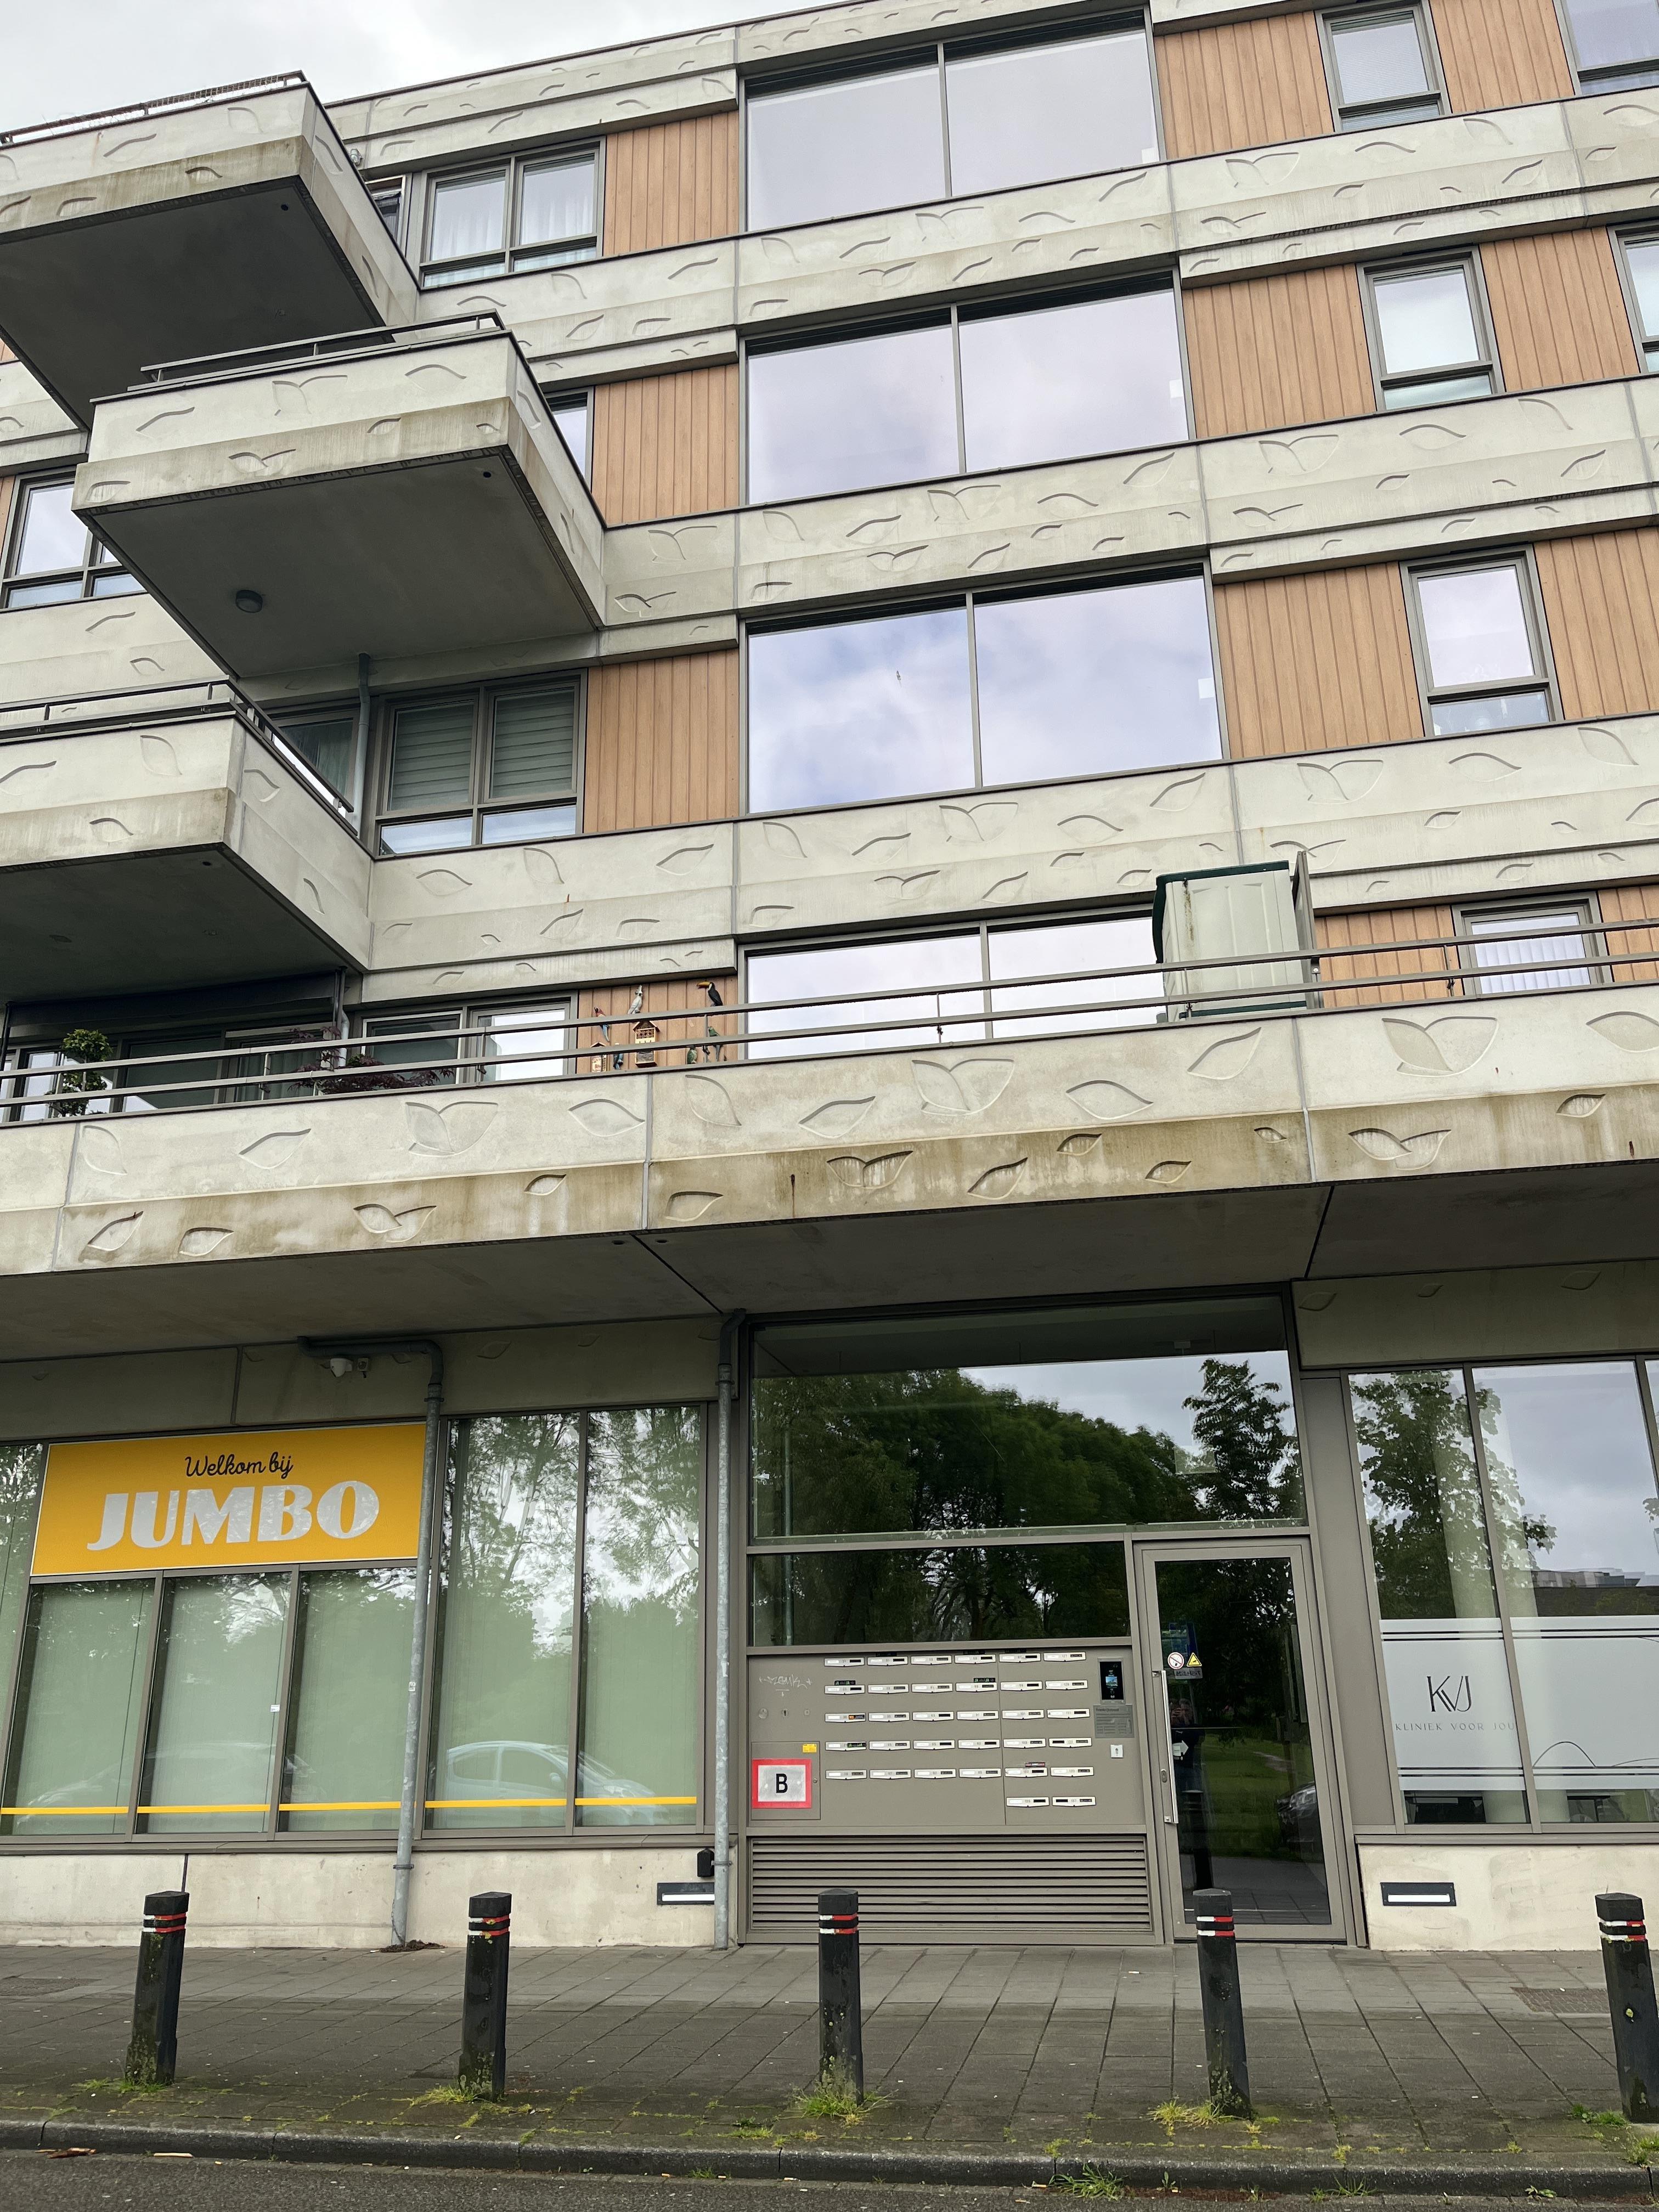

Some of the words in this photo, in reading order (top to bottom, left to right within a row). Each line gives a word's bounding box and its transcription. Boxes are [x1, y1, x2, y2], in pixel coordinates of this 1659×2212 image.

[184, 1453, 267, 1477] Welkom
[269, 1451, 294, 1480] bij
[87, 1480, 380, 1551] JUMBO
[1426, 1675, 1472, 1712] KVJ
[1395, 1723, 1442, 1731] KLINIEK
[1450, 1722, 1485, 1730] VOOR
[1493, 1722, 1516, 1730] JOU
[776, 1773, 788, 1793] B
